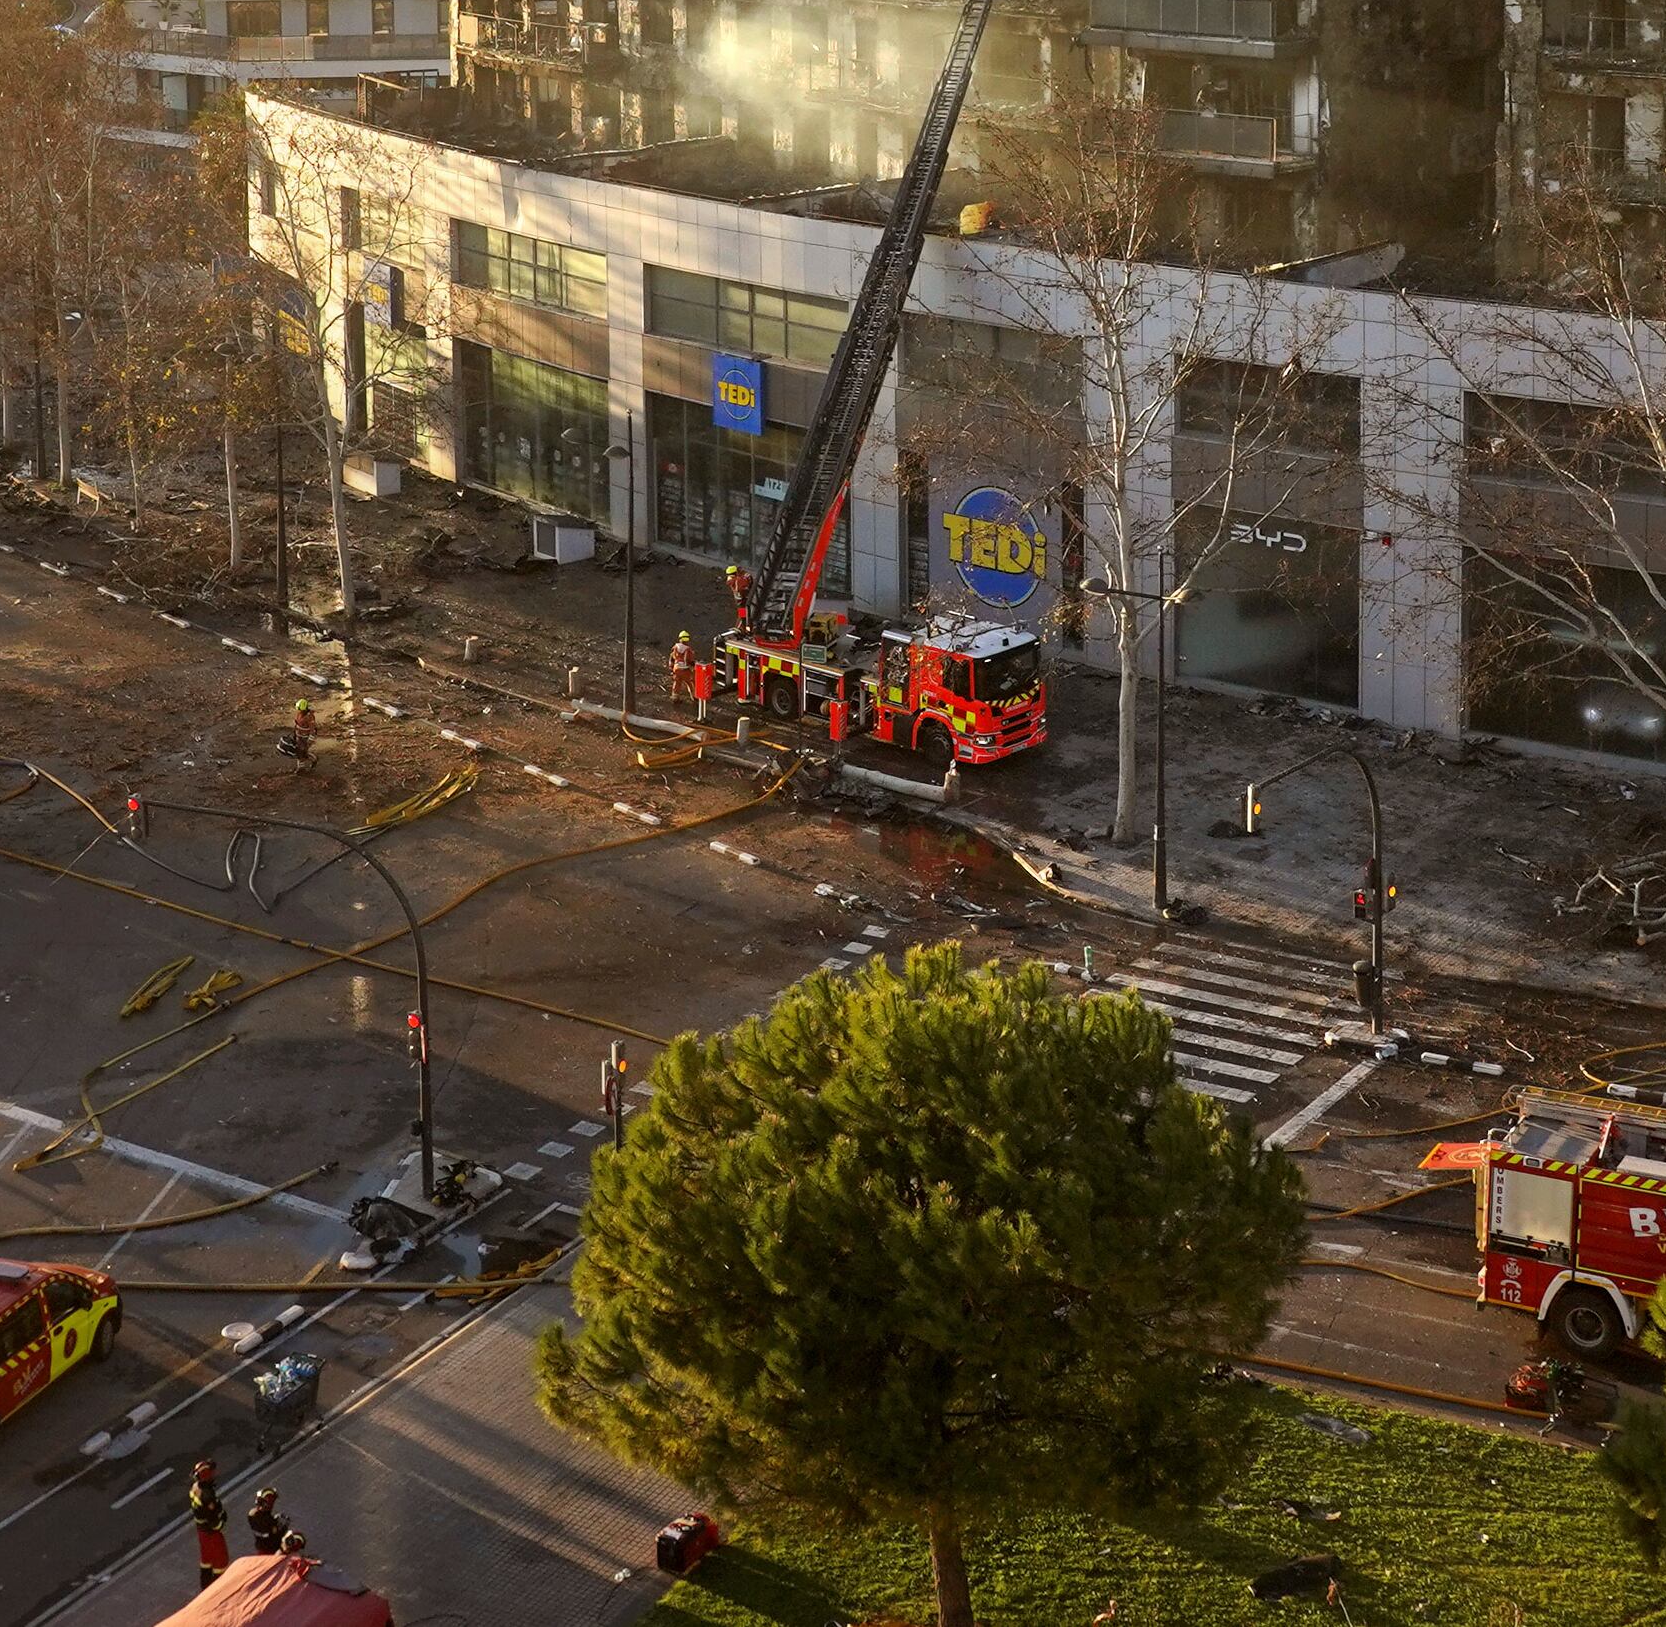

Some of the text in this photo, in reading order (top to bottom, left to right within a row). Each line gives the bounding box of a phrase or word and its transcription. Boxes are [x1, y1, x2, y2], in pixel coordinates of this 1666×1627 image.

[717, 380, 755, 408] TEDi
[942, 512, 1047, 581] TEDi
[1230, 523, 1307, 552] BYD
[1500, 1288, 1522, 1304] 112
